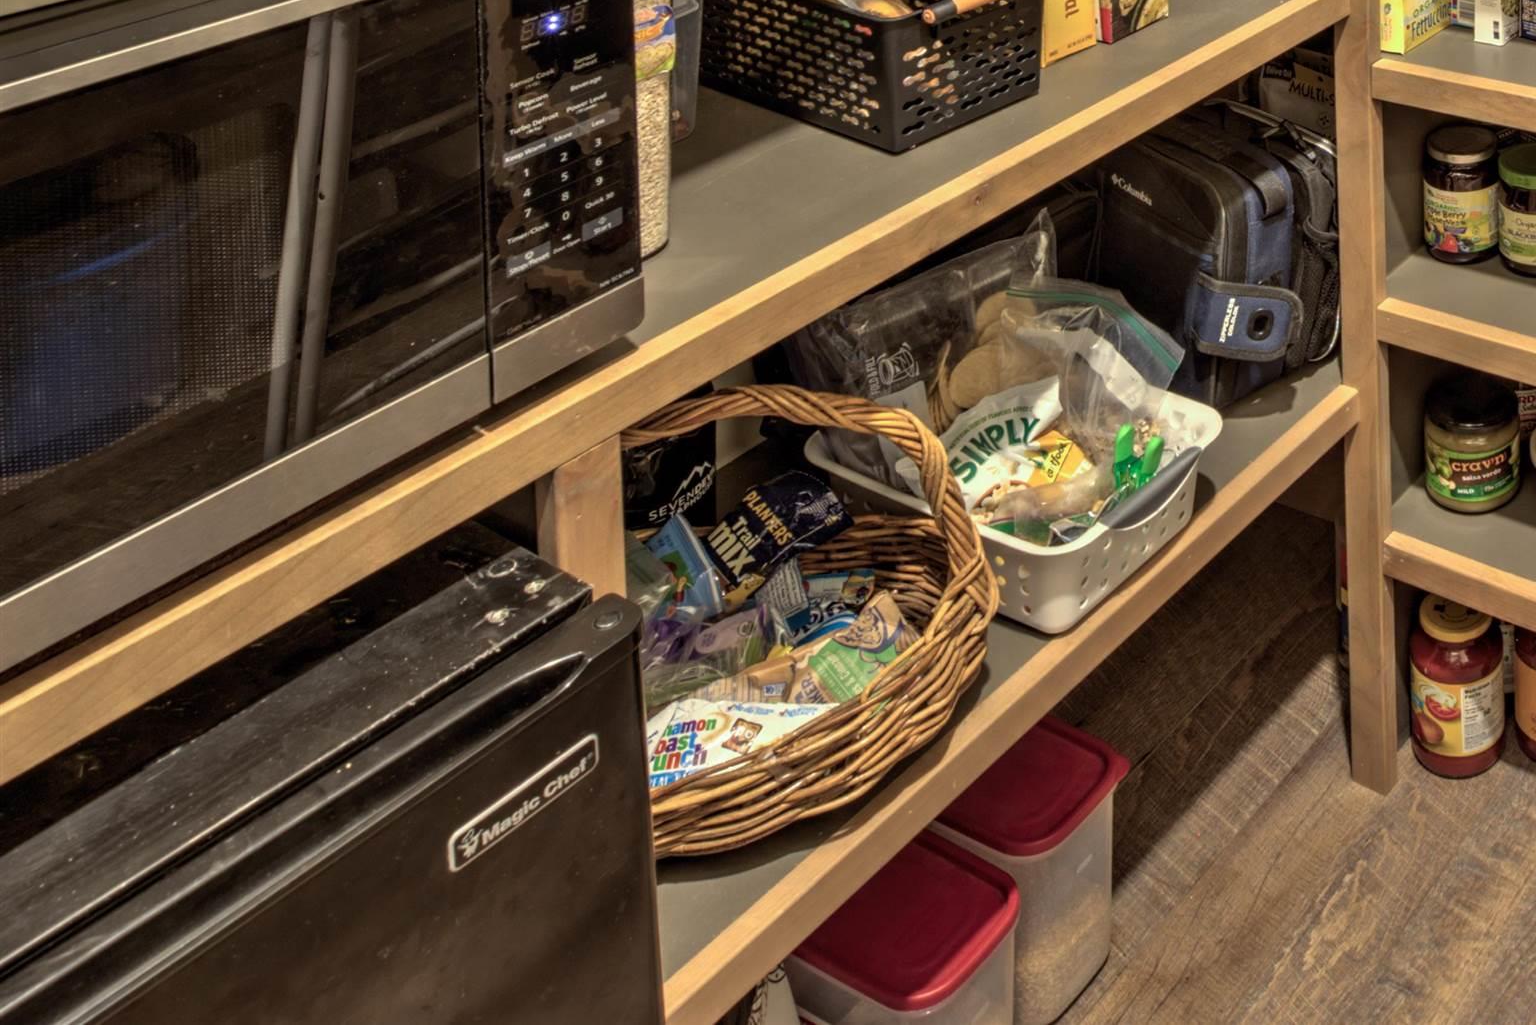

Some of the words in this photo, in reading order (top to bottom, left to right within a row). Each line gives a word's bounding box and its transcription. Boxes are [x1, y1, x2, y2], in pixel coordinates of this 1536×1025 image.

[510, 76, 535, 90] Sensor
[536, 68, 555, 79] Cook
[570, 75, 602, 92] Beverage
[518, 93, 549, 109] Popcorn
[566, 98, 588, 113] Power
[589, 92, 607, 105] Level
[509, 121, 531, 136] Turbo
[532, 112, 559, 127] Defrost
[594, 138, 602, 148] 3
[505, 150, 525, 163] Keep
[559, 152, 568, 162] 2
[595, 157, 603, 166] 6
[561, 172, 568, 182] 5
[595, 176, 603, 186] 9
[523, 187, 531, 197] 4
[561, 192, 569, 202] 8
[524, 208, 532, 218] 7
[562, 211, 570, 221] 0
[507, 222, 549, 245] Timer/Clock
[593, 223, 612, 236] Start
[949, 417, 1040, 485] SIMPLY
[1452, 453, 1505, 472] crav'n
[742, 490, 793, 547] PLANTERS
[733, 515, 762, 551] Trail
[707, 521, 755, 583] mix
[481, 795, 541, 846] Magic
[543, 757, 588, 798] Chef
